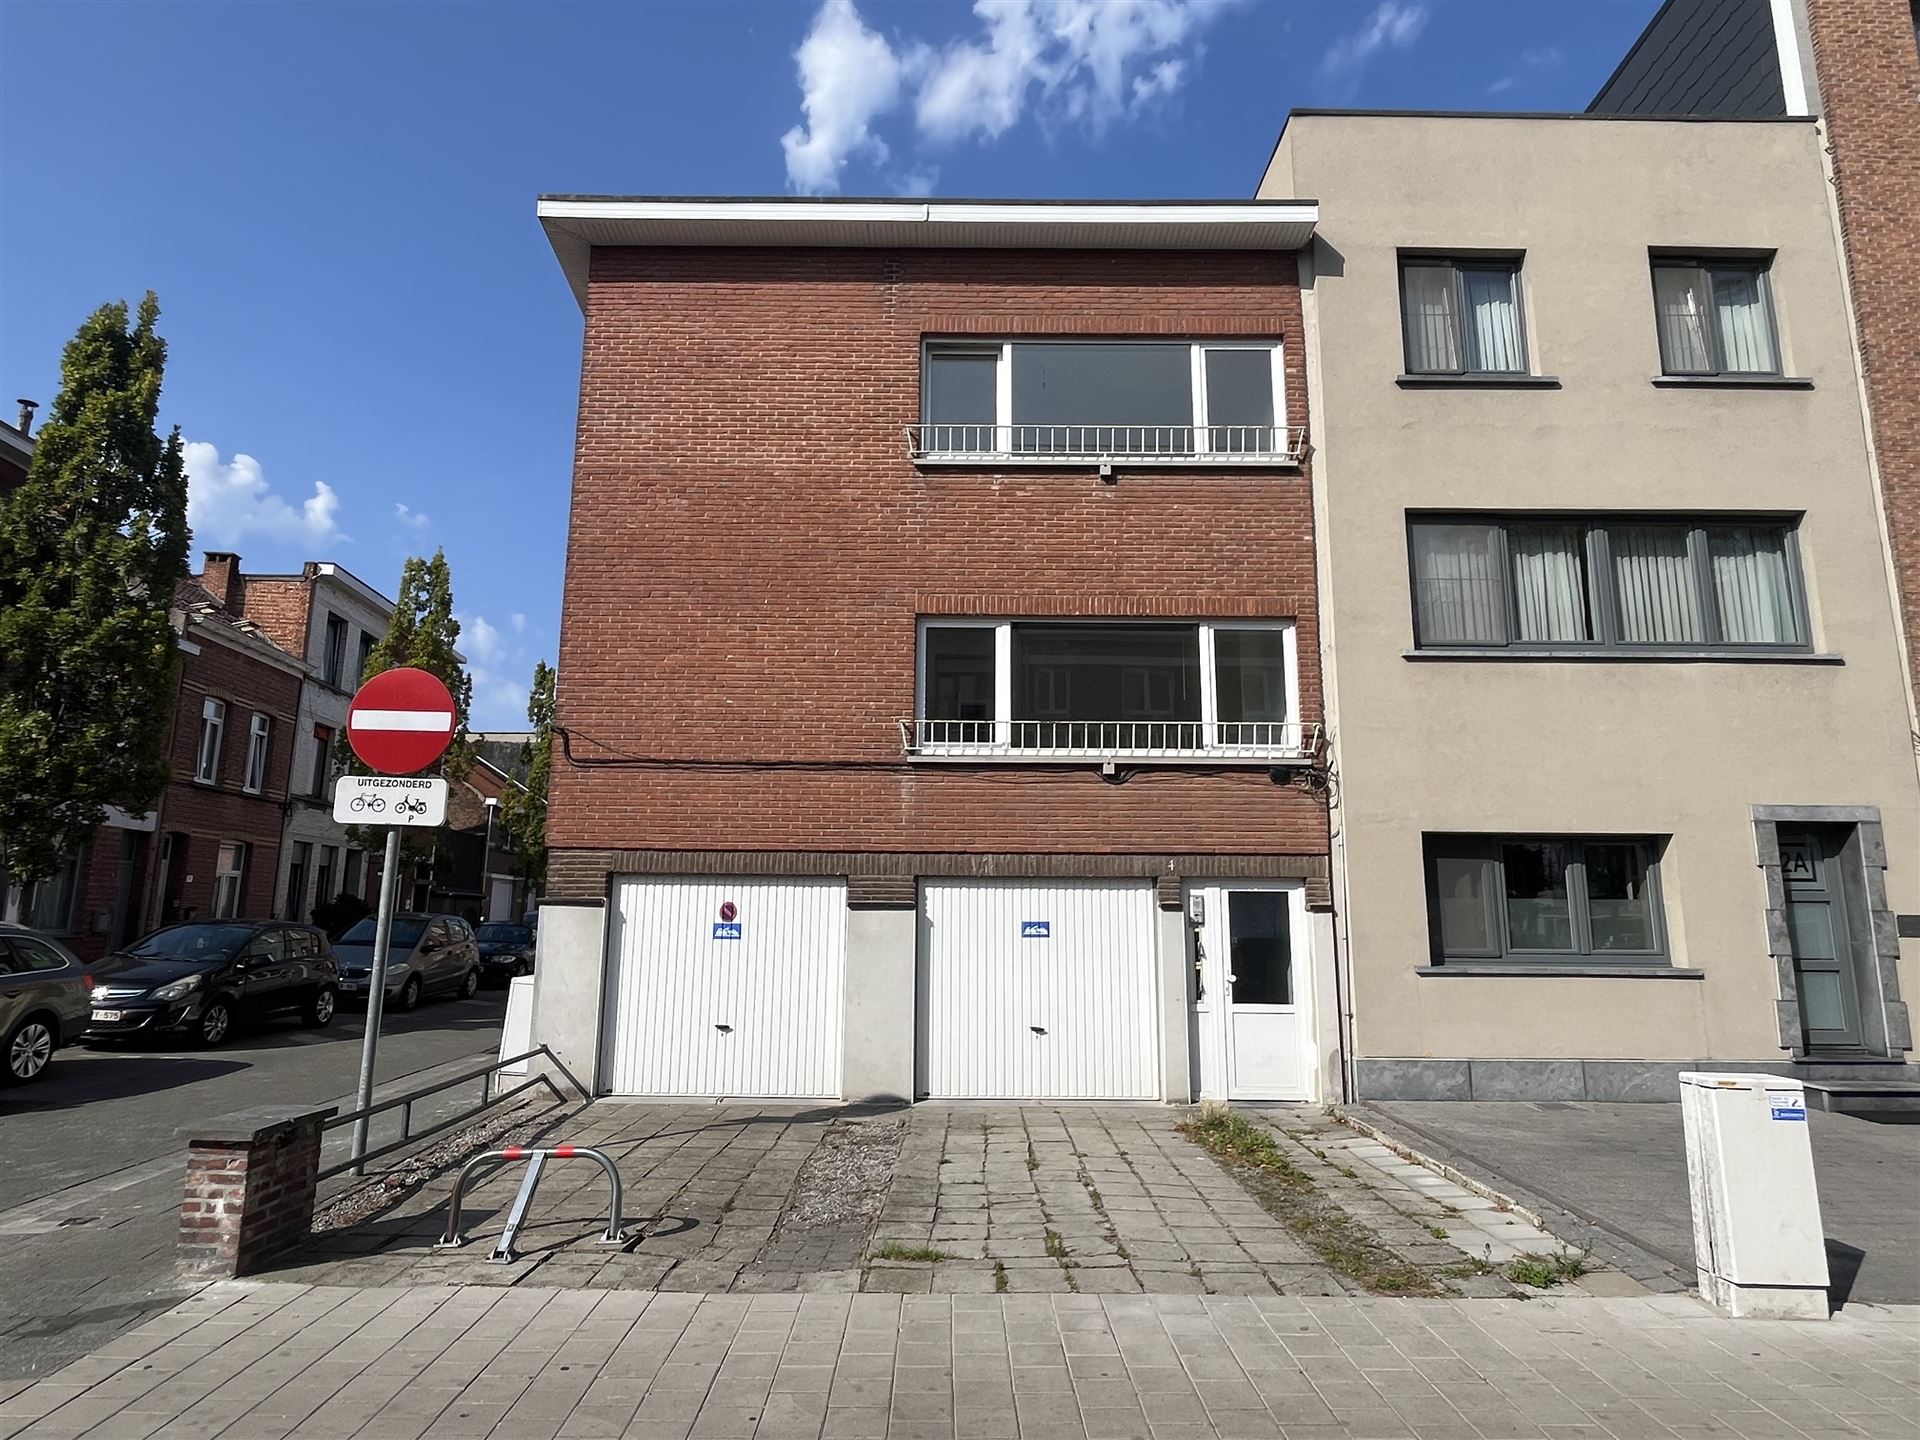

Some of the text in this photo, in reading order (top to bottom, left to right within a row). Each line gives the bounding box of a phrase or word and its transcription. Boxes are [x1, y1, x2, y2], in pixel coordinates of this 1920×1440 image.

[357, 778, 432, 789] UITGEZONDERD
[1168, 860, 1174, 870] 4
[1780, 851, 1809, 873] 2A
